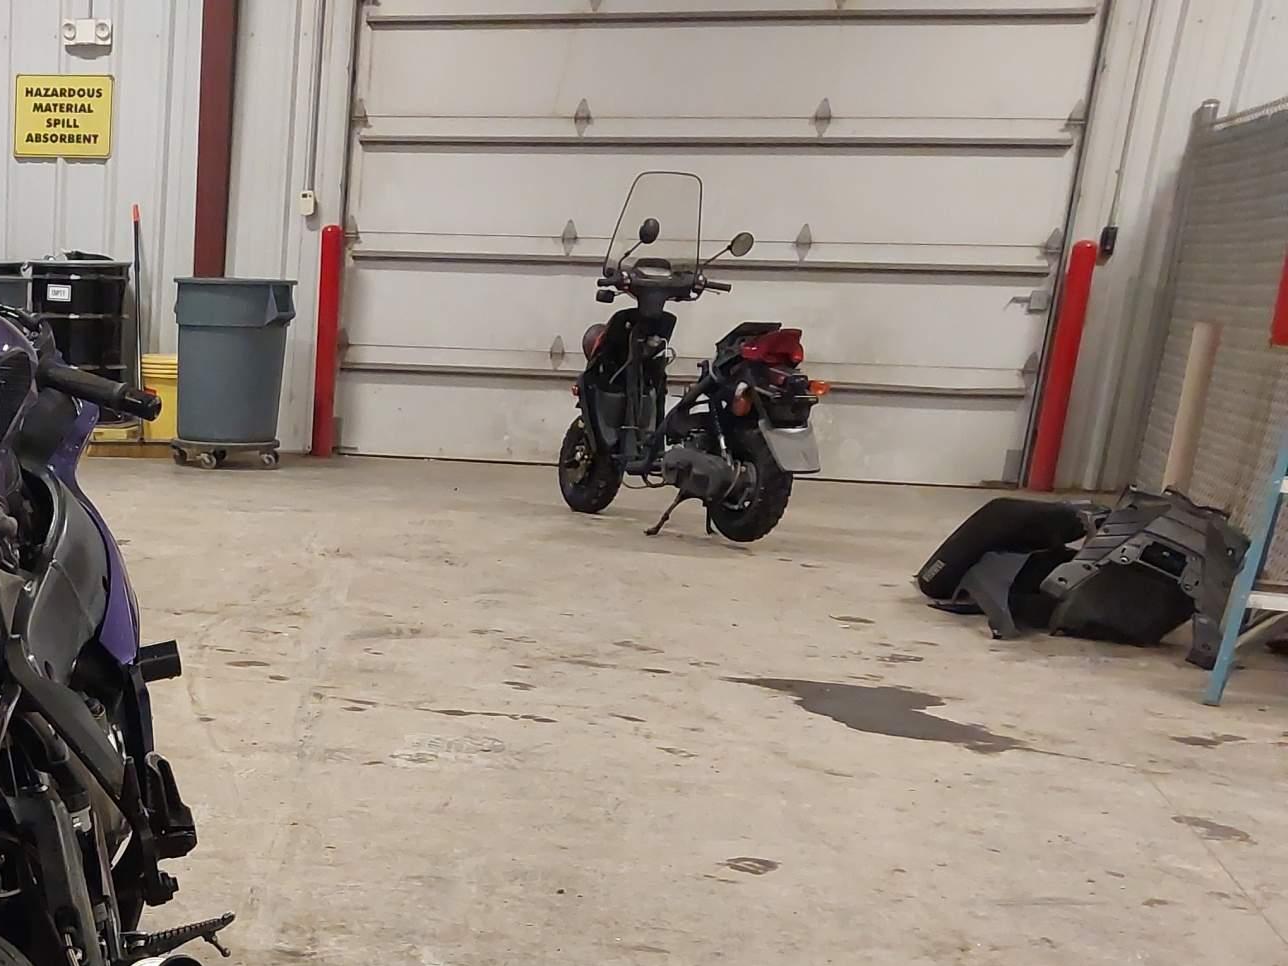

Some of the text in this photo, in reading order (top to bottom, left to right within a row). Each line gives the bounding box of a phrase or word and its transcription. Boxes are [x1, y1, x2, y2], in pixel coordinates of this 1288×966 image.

[25, 87, 103, 98] HAZARDOUS
[32, 102, 94, 113] MATERIAL
[46, 118, 80, 128] SPILL
[25, 133, 99, 144] ABSORBENT
